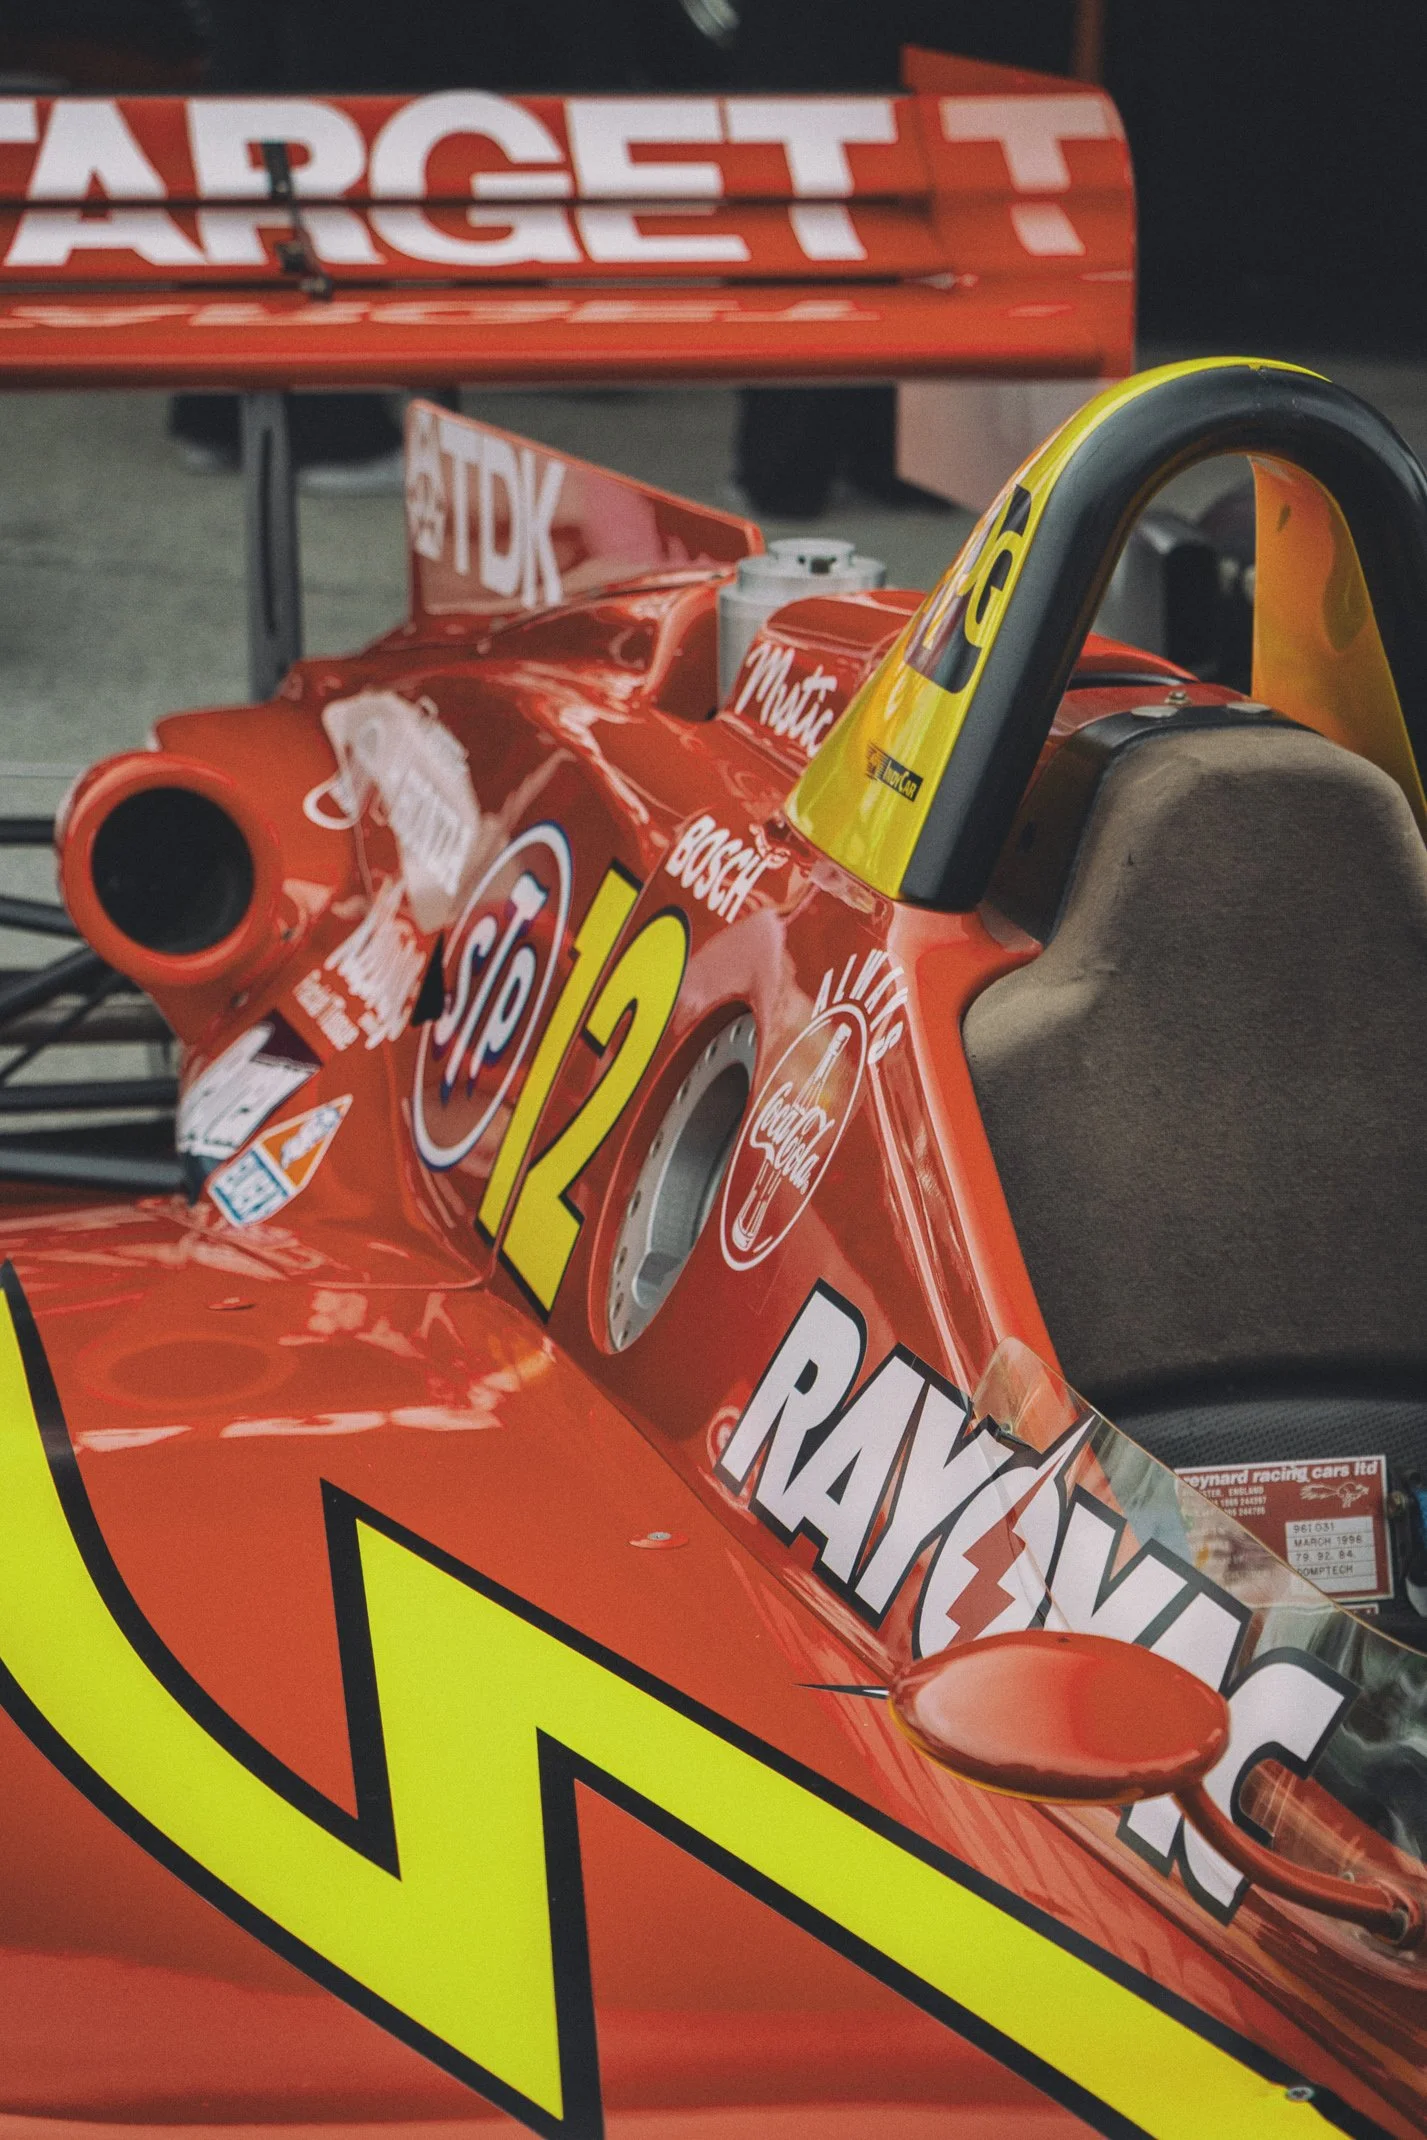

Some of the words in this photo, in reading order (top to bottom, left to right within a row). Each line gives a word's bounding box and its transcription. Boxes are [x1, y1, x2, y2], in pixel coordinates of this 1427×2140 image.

[0, 90, 898, 266] ARGET
[438, 418, 568, 611] TDK
[664, 814, 766, 924] BOSCH
[430, 870, 549, 1106] STP
[811, 948, 908, 1065] ALWAYS
[475, 861, 689, 1323] 12
[1253, 1465, 1310, 1483] racing
[1312, 1465, 1350, 1479] cars
[1354, 1461, 1378, 1476] ltd
[1294, 1537, 1331, 1547] MARCH
